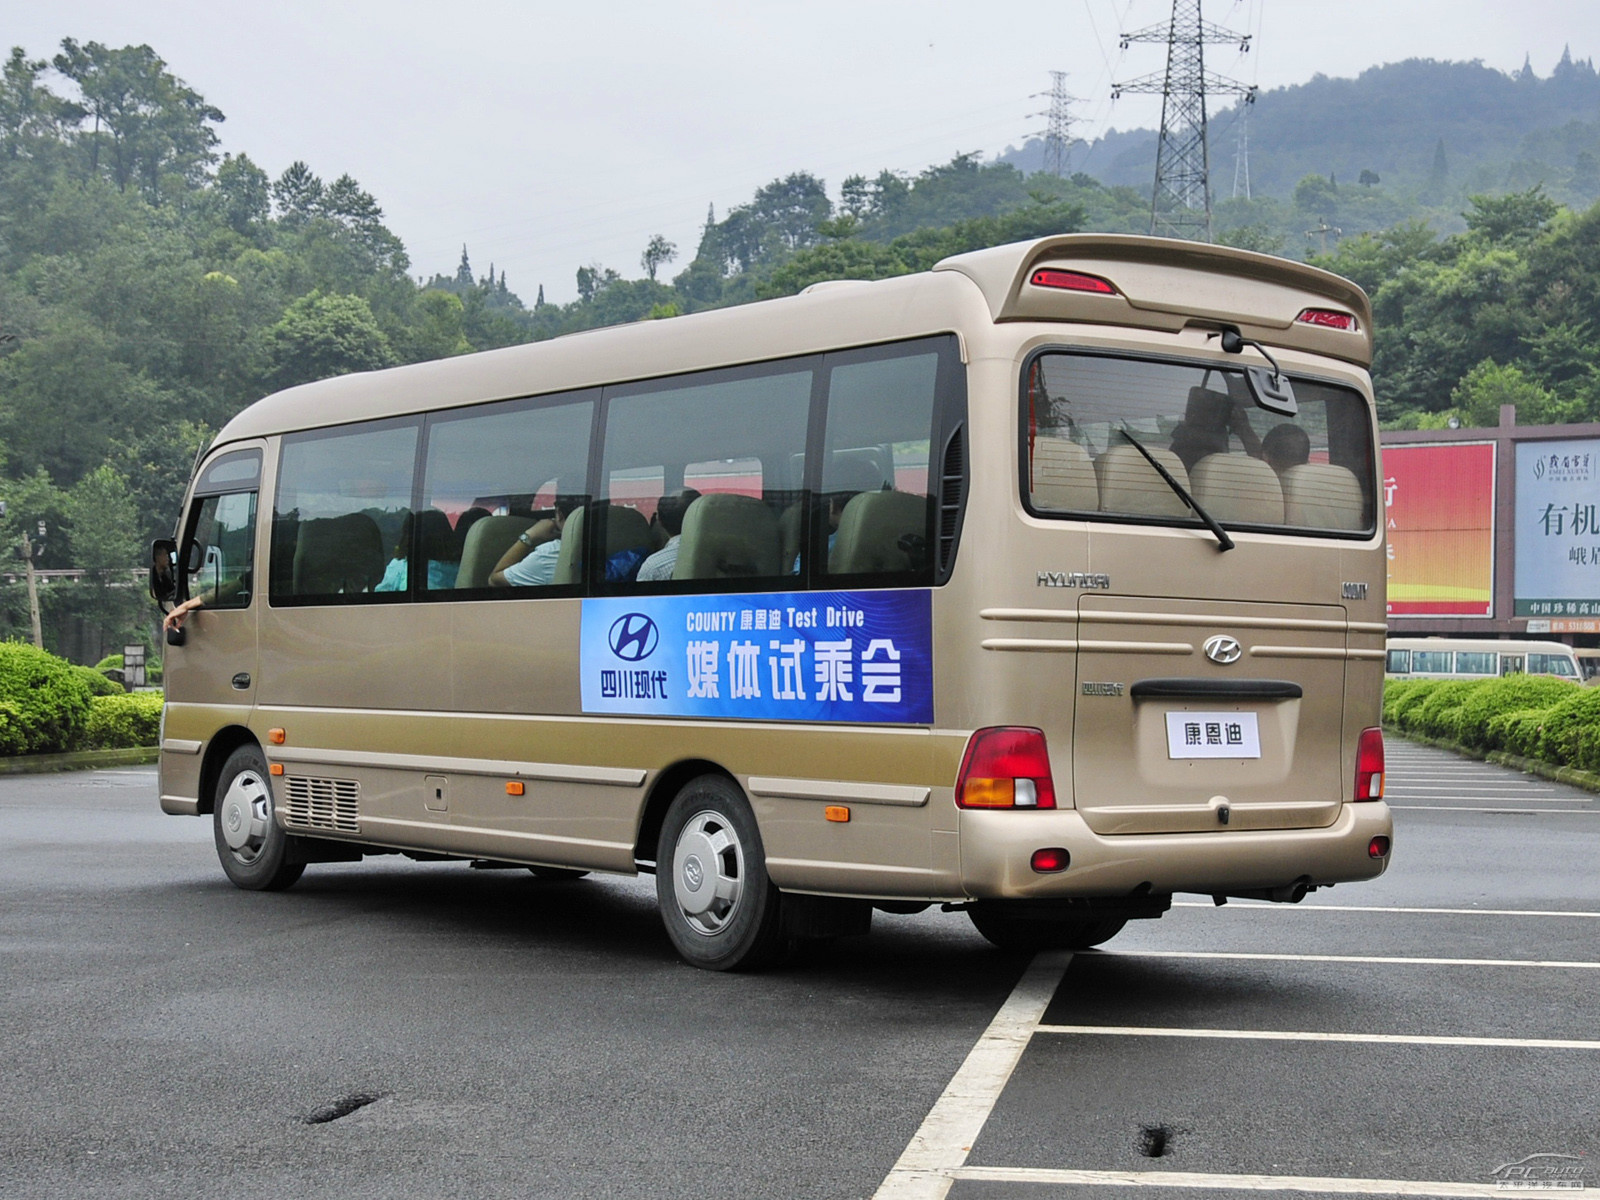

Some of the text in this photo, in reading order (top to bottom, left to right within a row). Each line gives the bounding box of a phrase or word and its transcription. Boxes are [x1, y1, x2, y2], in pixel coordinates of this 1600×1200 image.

[686, 606, 865, 632] COUNTY 康恩迪 Test Drive
[686, 638, 901, 703] 媒体试乘会
[601, 670, 668, 700] 四川现代
[1184, 722, 1244, 746] 康恩迪
